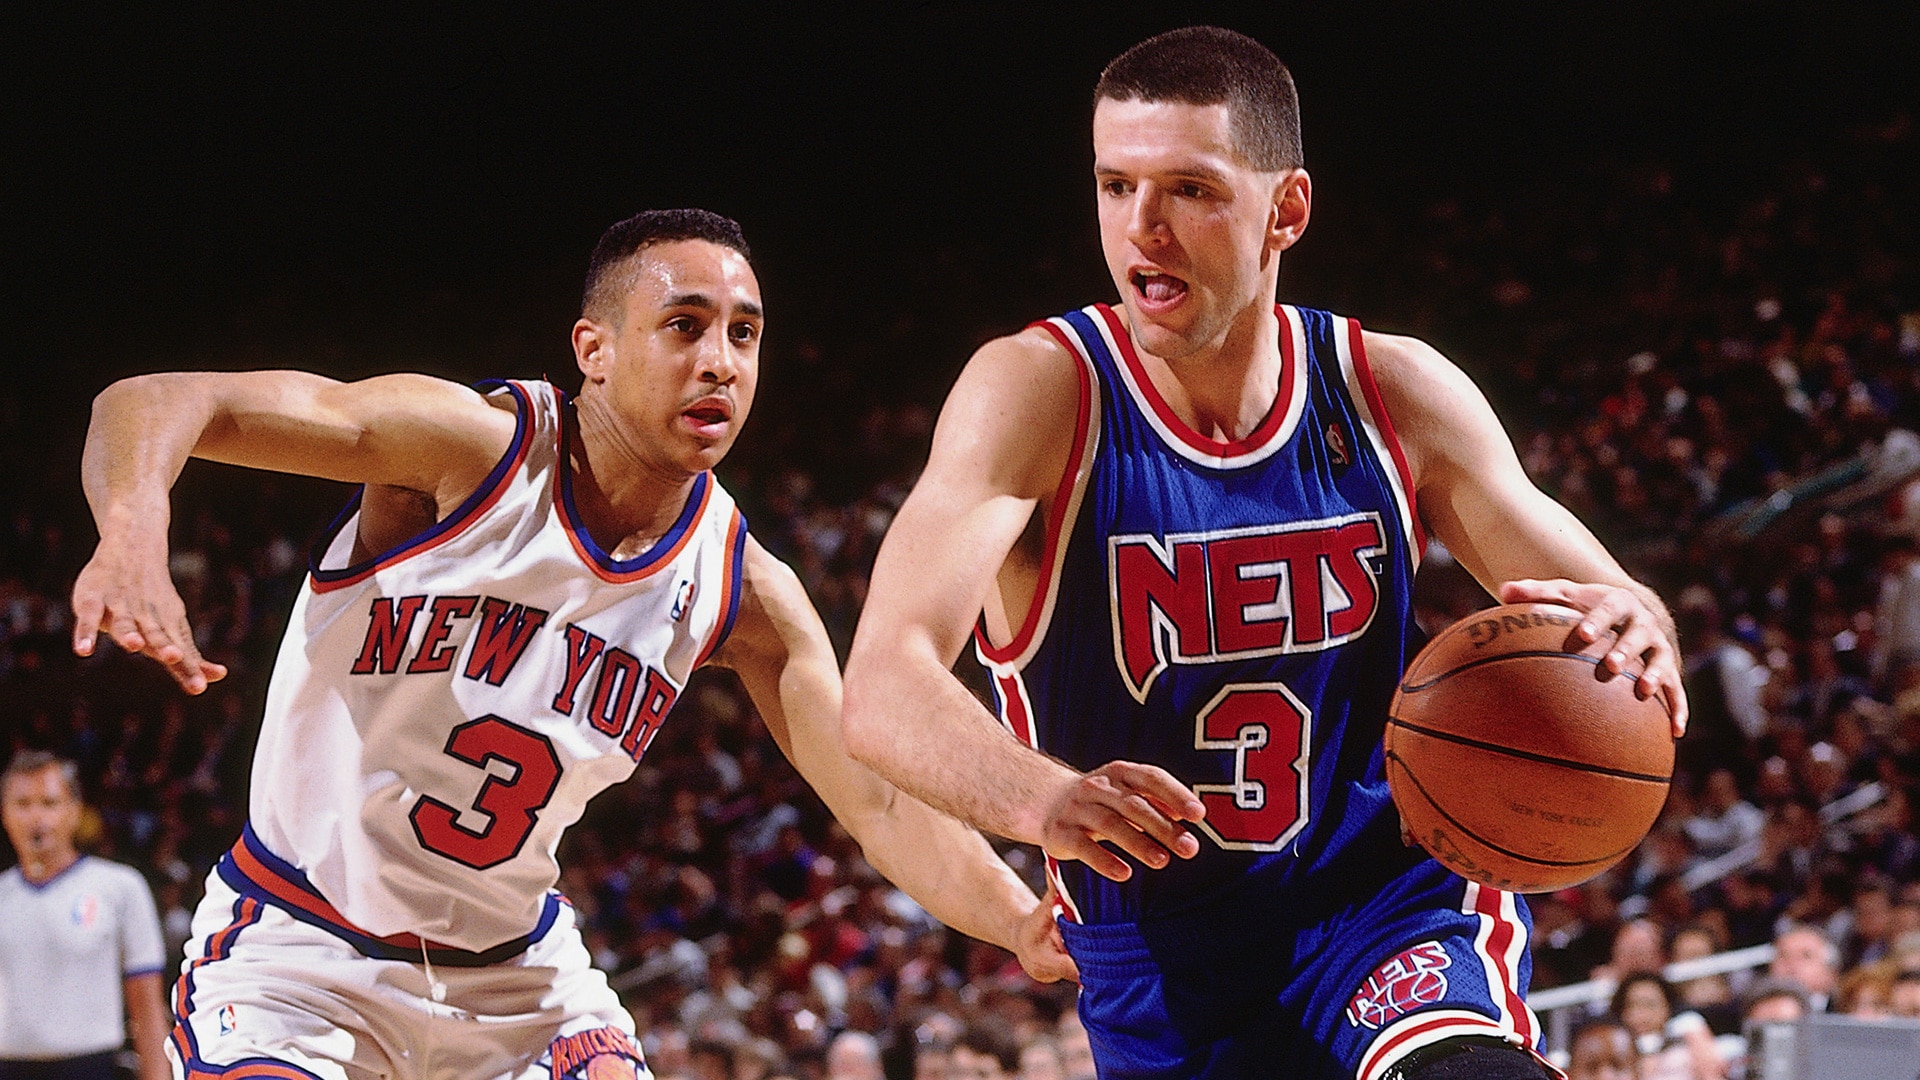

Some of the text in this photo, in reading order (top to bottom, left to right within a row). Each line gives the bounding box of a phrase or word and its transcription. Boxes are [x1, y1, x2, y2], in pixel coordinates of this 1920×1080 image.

[350, 595, 677, 763] NEW YOR
[1108, 511, 1387, 705] NETS
[408, 713, 564, 871] 3
[1192, 682, 1312, 852] 3
[549, 1024, 645, 1080] KNICKS
[1346, 940, 1453, 1028] NETS
